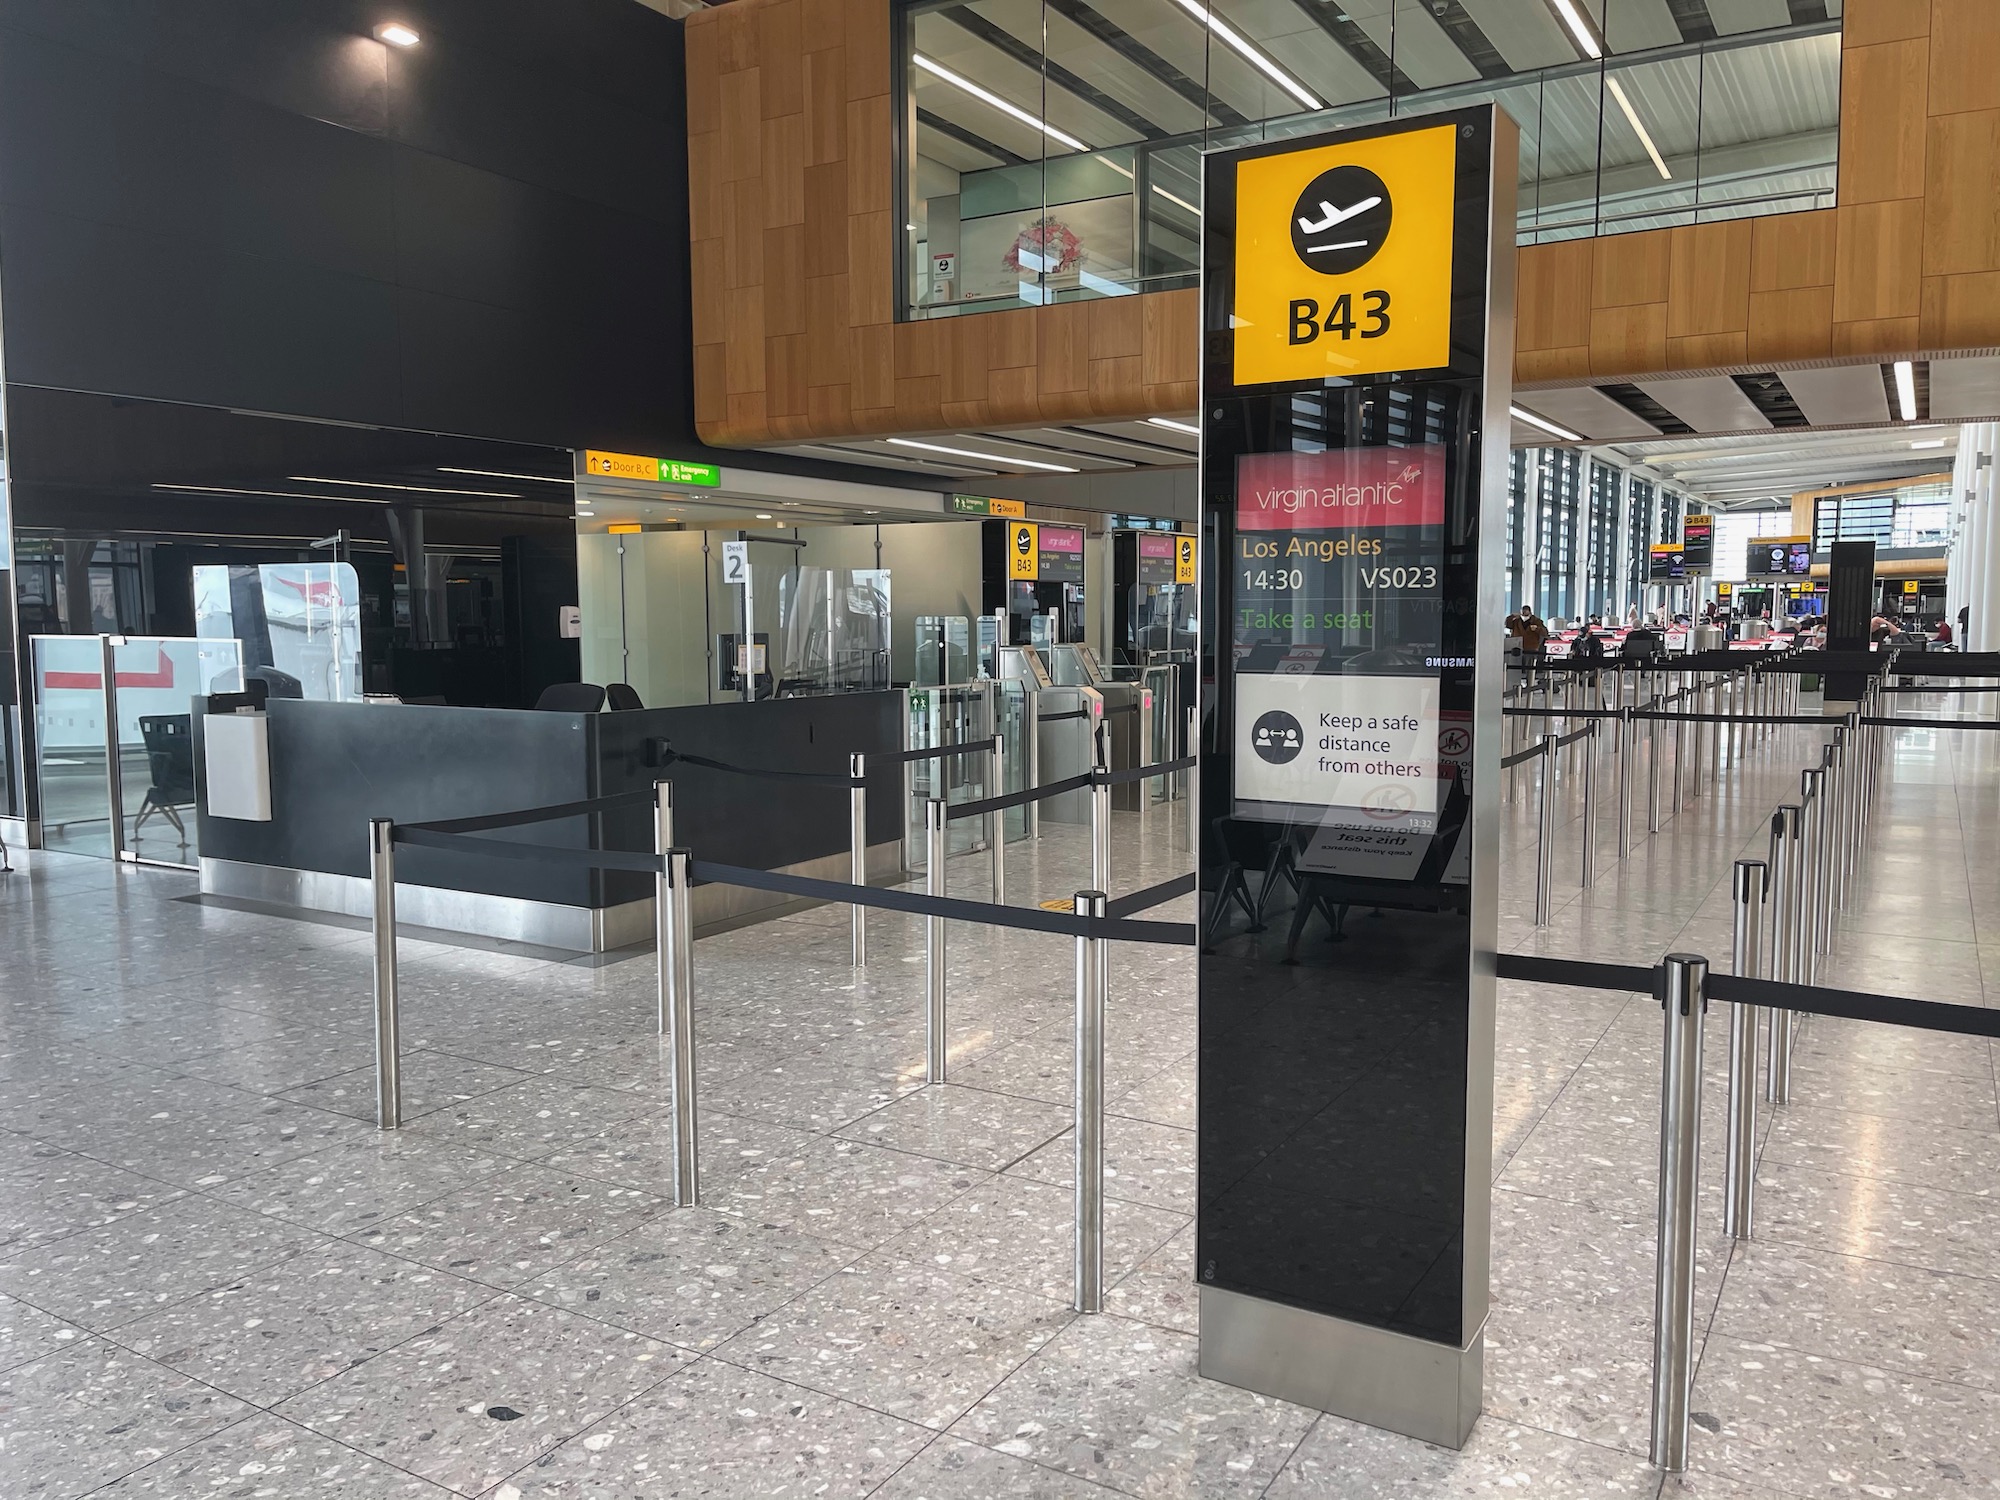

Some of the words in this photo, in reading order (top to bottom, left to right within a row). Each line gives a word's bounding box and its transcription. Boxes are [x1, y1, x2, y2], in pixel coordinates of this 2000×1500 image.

[1288, 289, 1392, 346] B43
[613, 461, 635, 473] Door
[680, 464, 709, 476] Emergency
[681, 473, 692, 481] exit
[1256, 485, 1318, 514] virgin
[1321, 481, 1403, 508] atlantic
[1002, 505, 1013, 513] Door
[726, 544, 743, 552] Desk
[1241, 538, 1279, 559] Los
[1285, 534, 1382, 562] Angeles
[729, 555, 743, 578] 2
[1017, 559, 1032, 572] B43
[1181, 567, 1191, 577] B43
[1243, 568, 1303, 590] 14:30
[1360, 566, 1437, 589] VS023
[1241, 607, 1295, 629] Take
[1303, 613, 1316, 629] a
[1323, 609, 1373, 629] seat
[1319, 713, 1363, 732] Keep
[1367, 718, 1378, 729] a
[1382, 715, 1419, 731] safe
[1319, 735, 1391, 753] distance
[1318, 757, 1360, 775] from
[1364, 761, 1422, 778] others
[1408, 818, 1432, 828] 13:32
